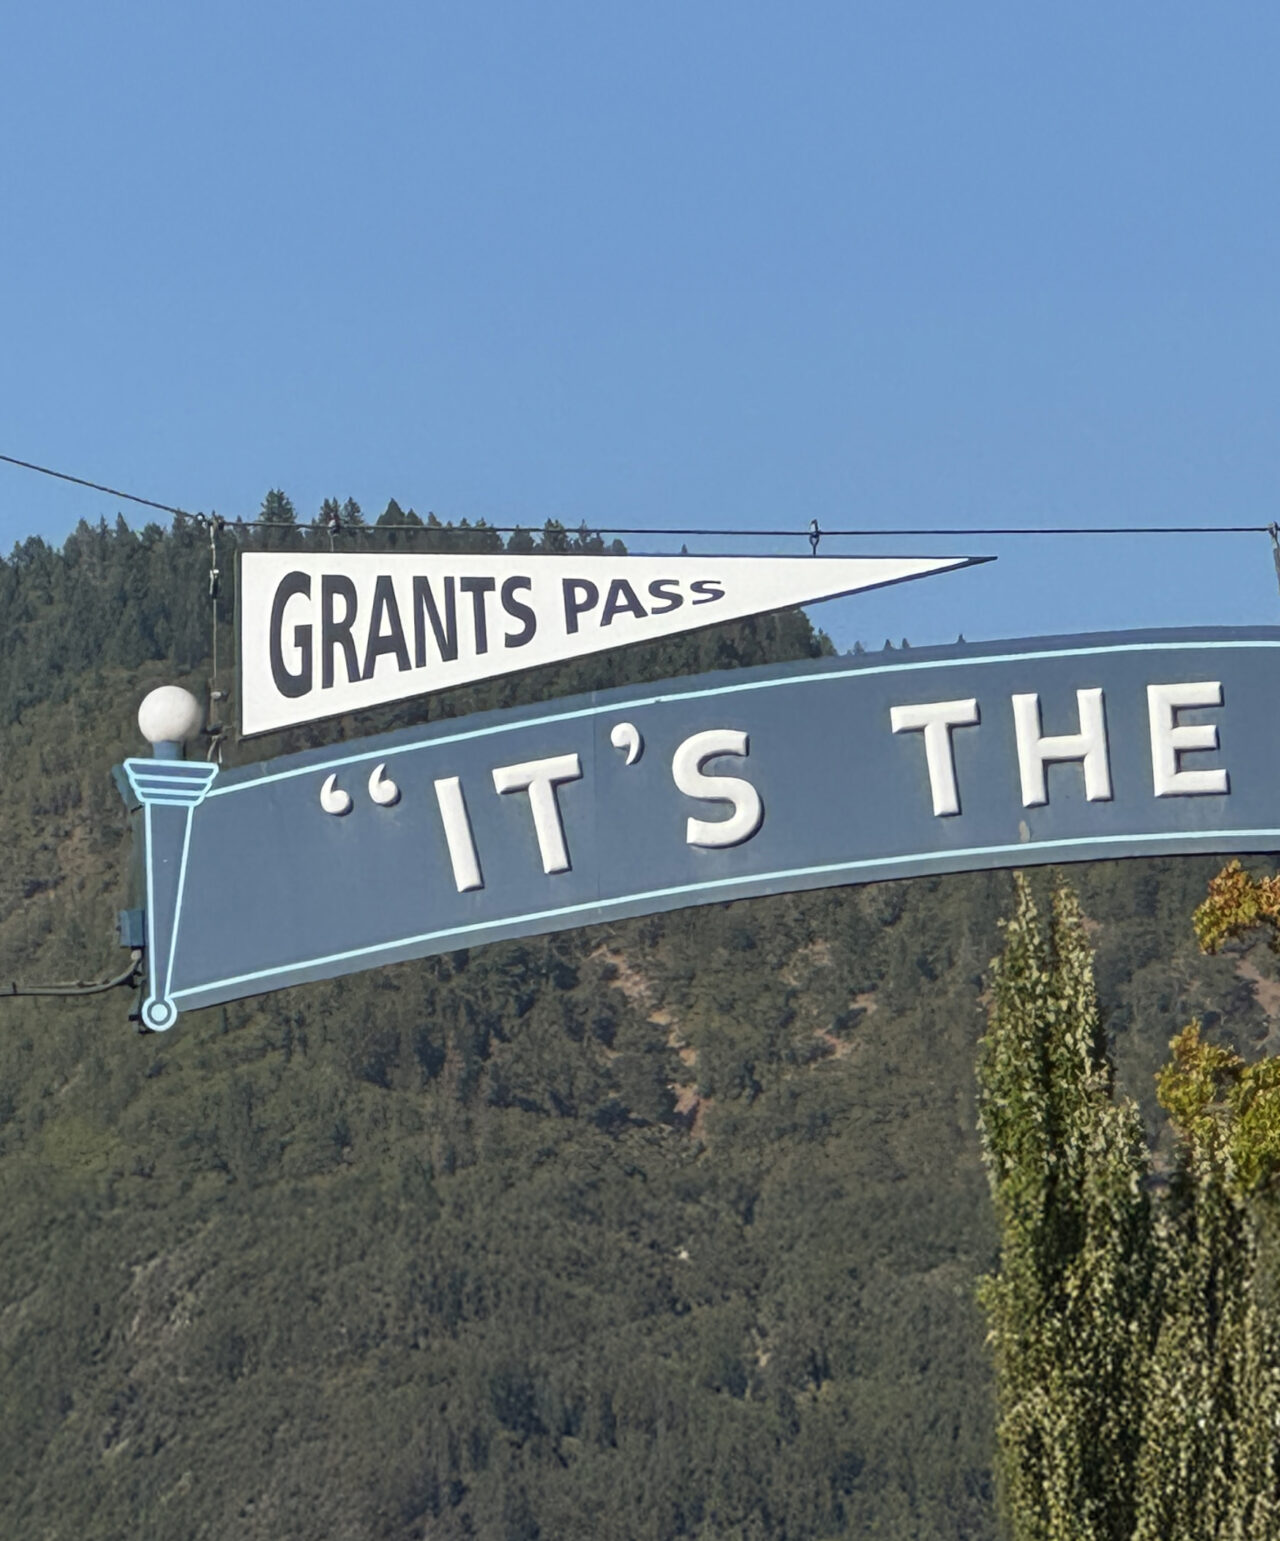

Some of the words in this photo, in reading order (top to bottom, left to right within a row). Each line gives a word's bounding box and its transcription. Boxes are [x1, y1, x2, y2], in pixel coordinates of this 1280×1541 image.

[269, 570, 537, 698] GRANTS
[562, 577, 726, 634] PASS
[319, 722, 765, 893] “IT’S
[890, 681, 1230, 817] THE
